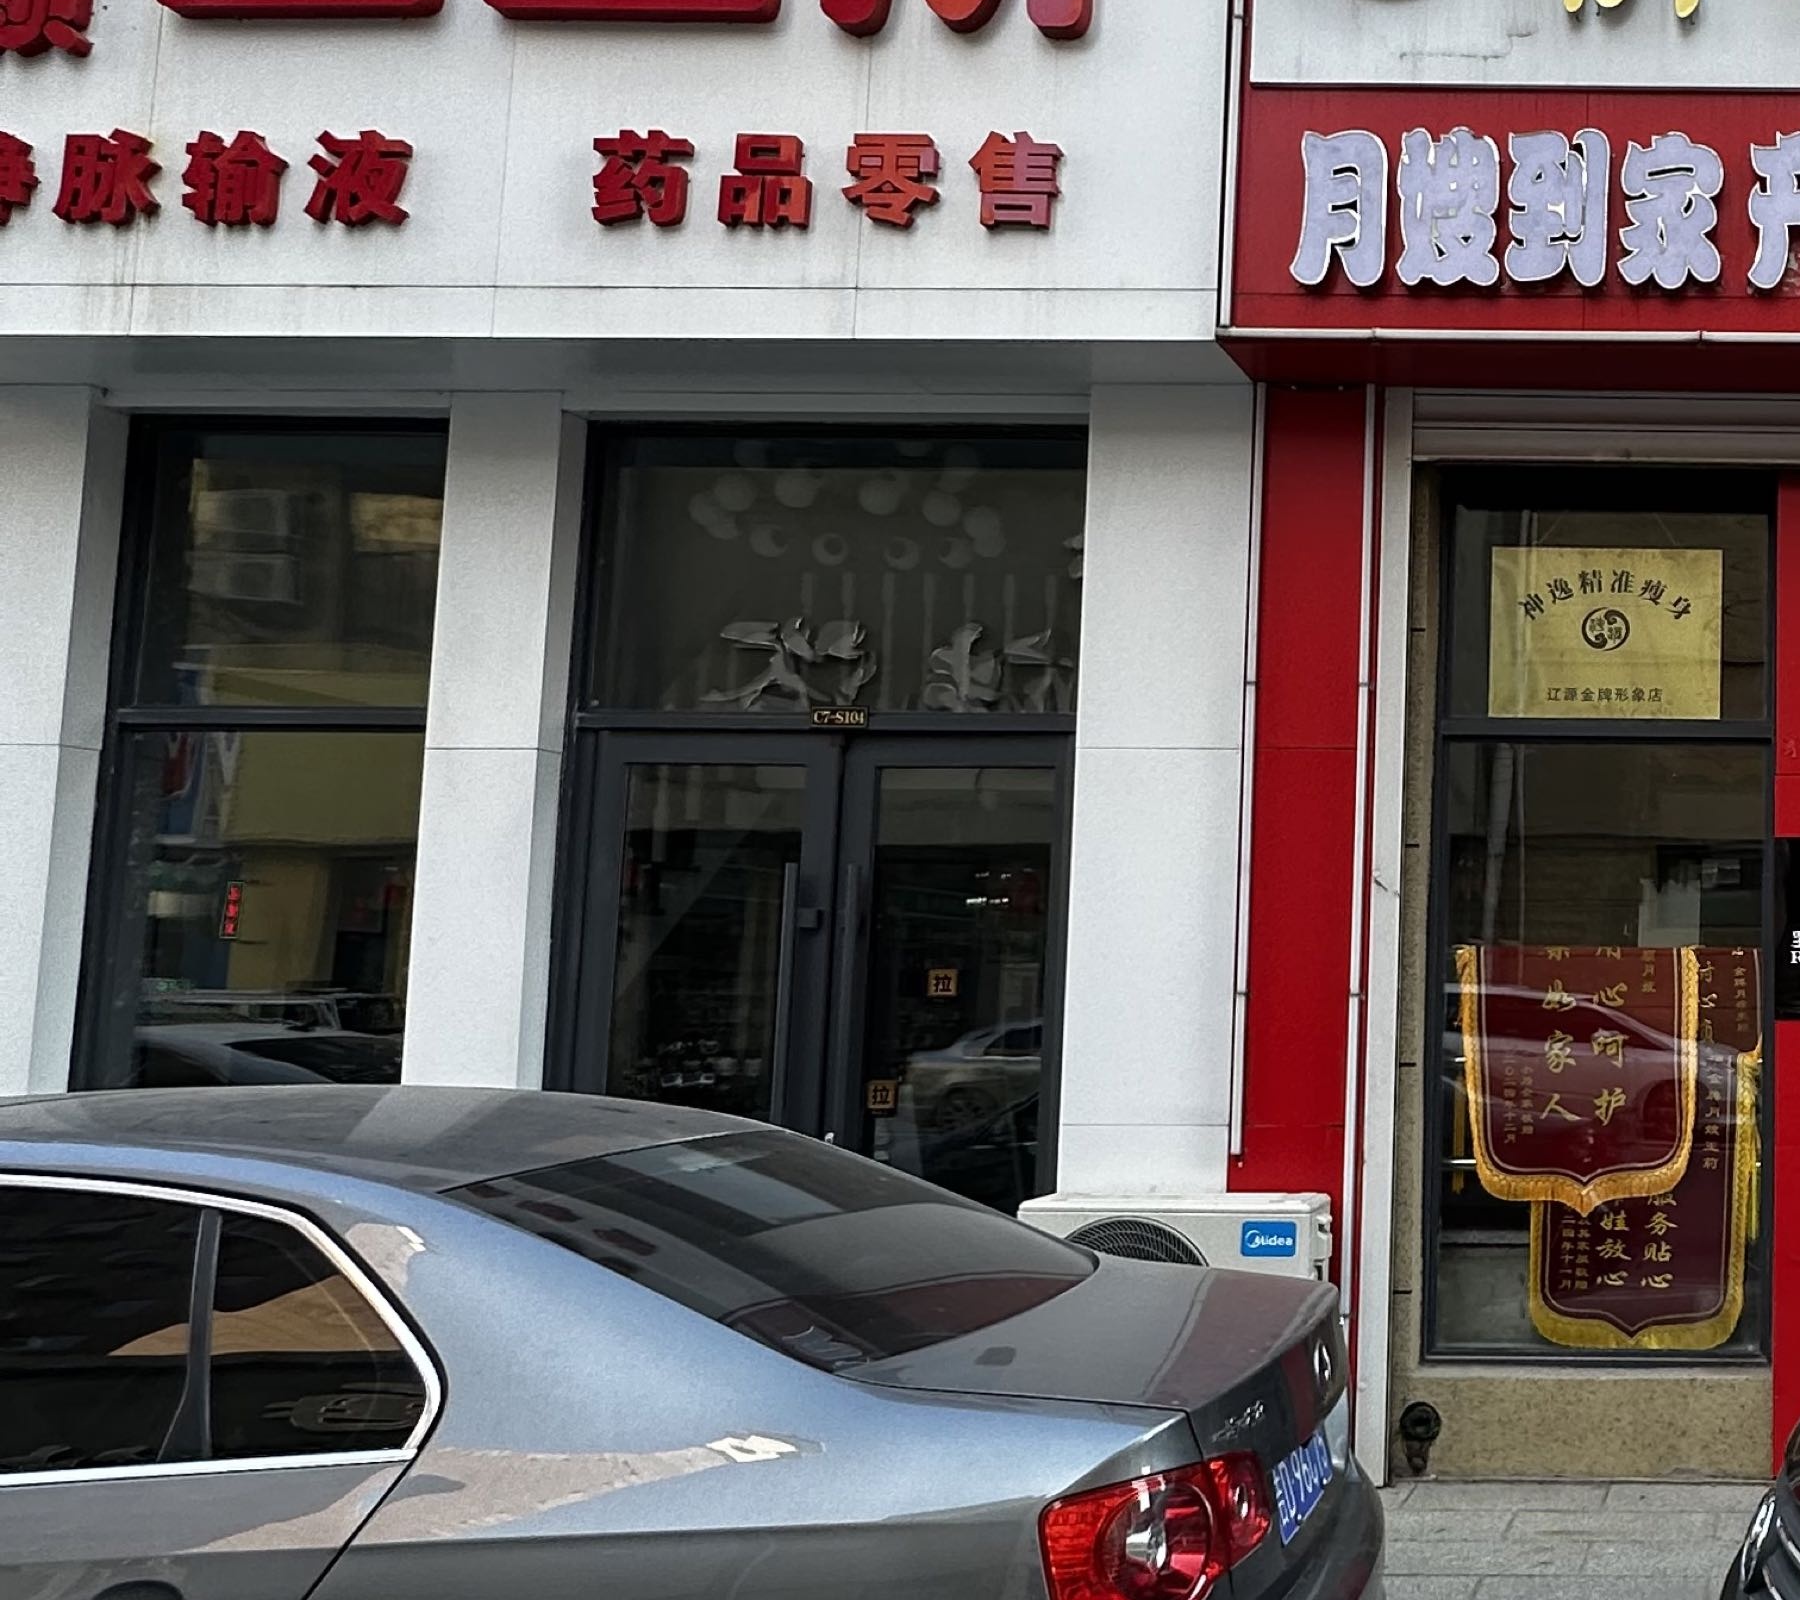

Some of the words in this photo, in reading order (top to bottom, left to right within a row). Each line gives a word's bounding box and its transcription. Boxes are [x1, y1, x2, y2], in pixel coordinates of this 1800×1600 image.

[591, 128, 1066, 229] 药品零售
[1547, 687, 1663, 703] 辽源金牌形象店
[813, 710, 865, 725] C7-S104
[935, 973, 953, 993] 拉
[872, 1085, 890, 1106] 拉
[1248, 1229, 1294, 1249] Midea
[1595, 1200, 1632, 1288] 娃放心
